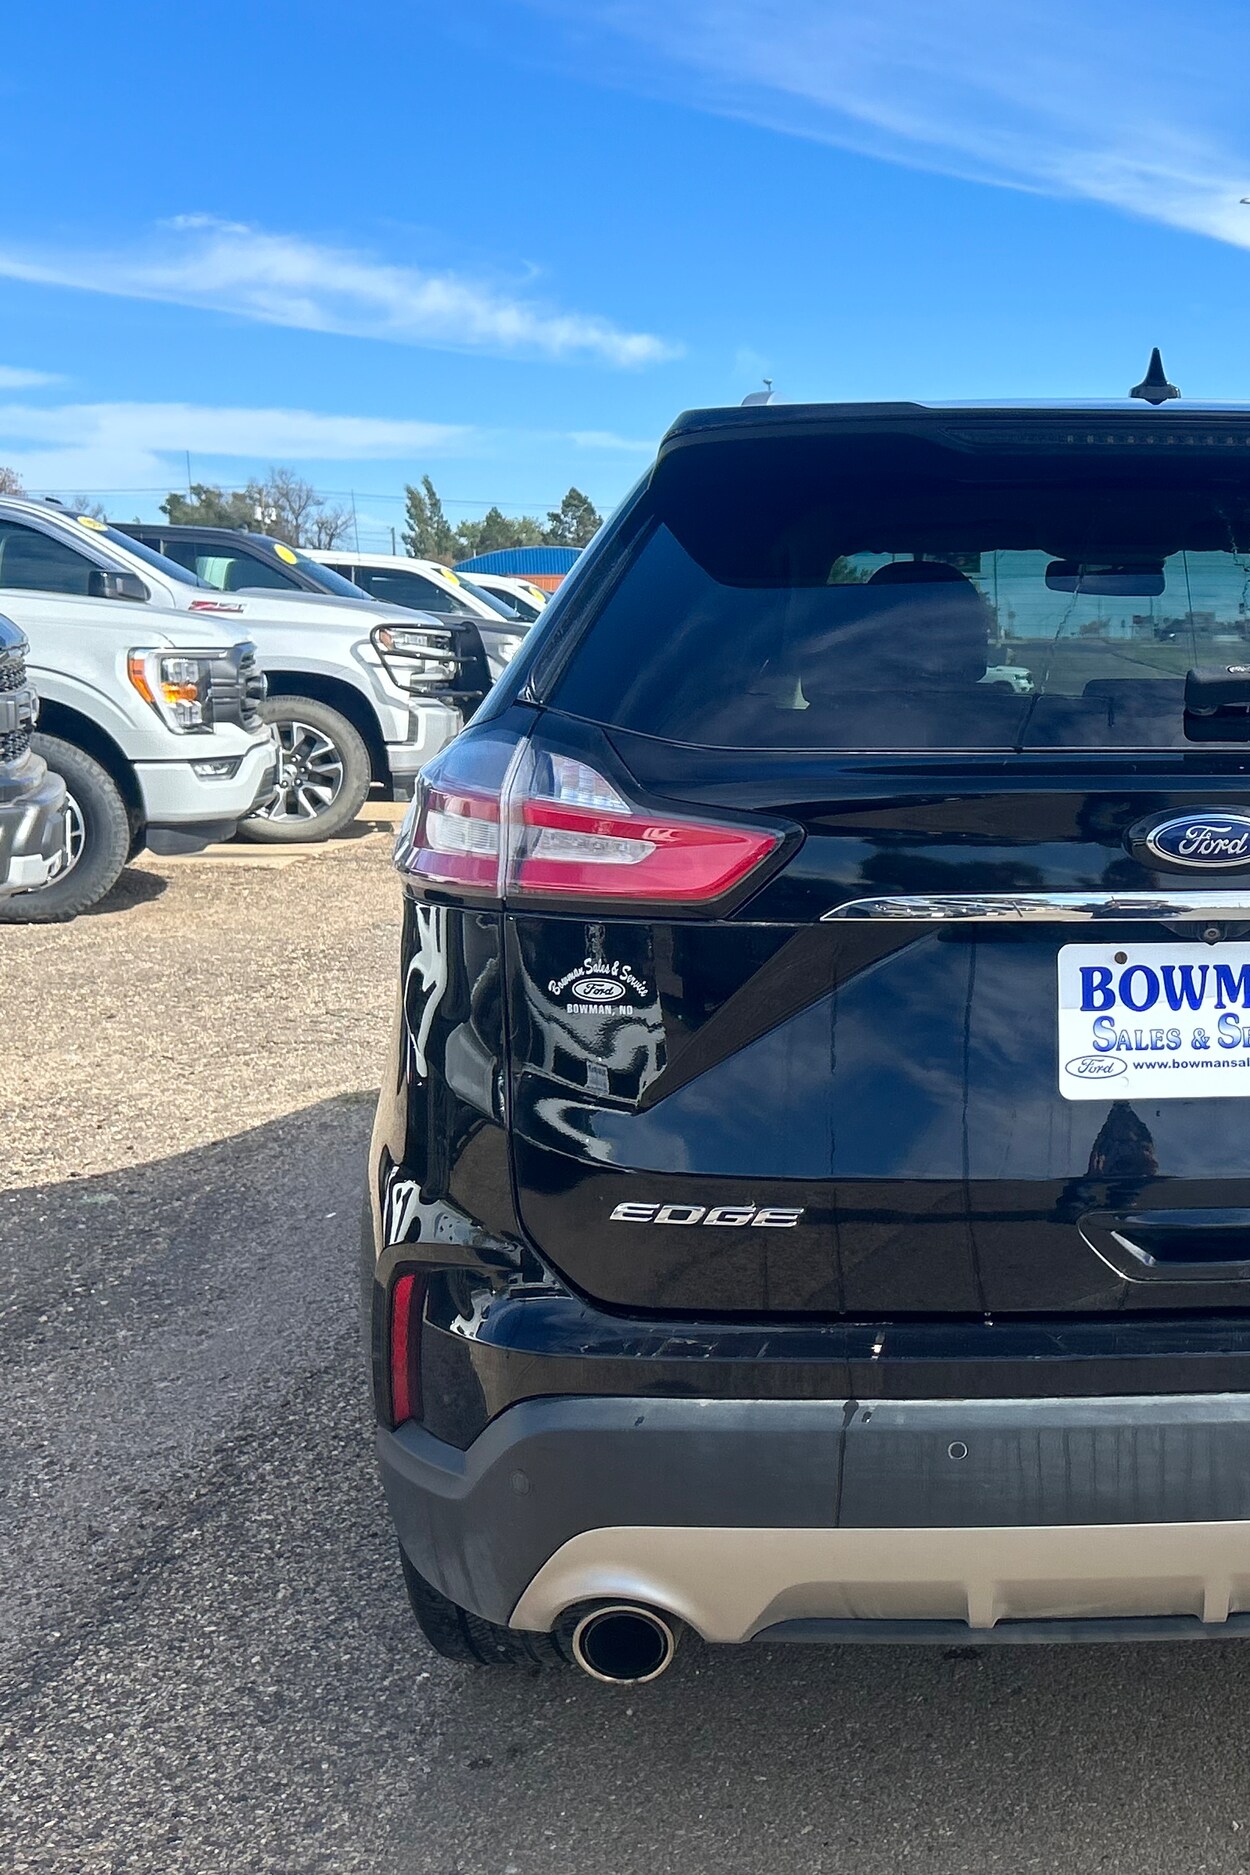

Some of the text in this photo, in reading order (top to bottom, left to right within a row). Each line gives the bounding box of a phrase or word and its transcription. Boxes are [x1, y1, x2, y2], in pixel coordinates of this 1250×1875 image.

[1178, 825, 1249, 855] Ford
[548, 958, 649, 997] Bowman Sales & Service
[583, 983, 614, 996] Ford
[566, 1004, 634, 1016] BOWMAN, ND
[1190, 1028, 1211, 1050] &
[1077, 1058, 1115, 1074] Ford
[609, 1202, 805, 1228] EDGE
